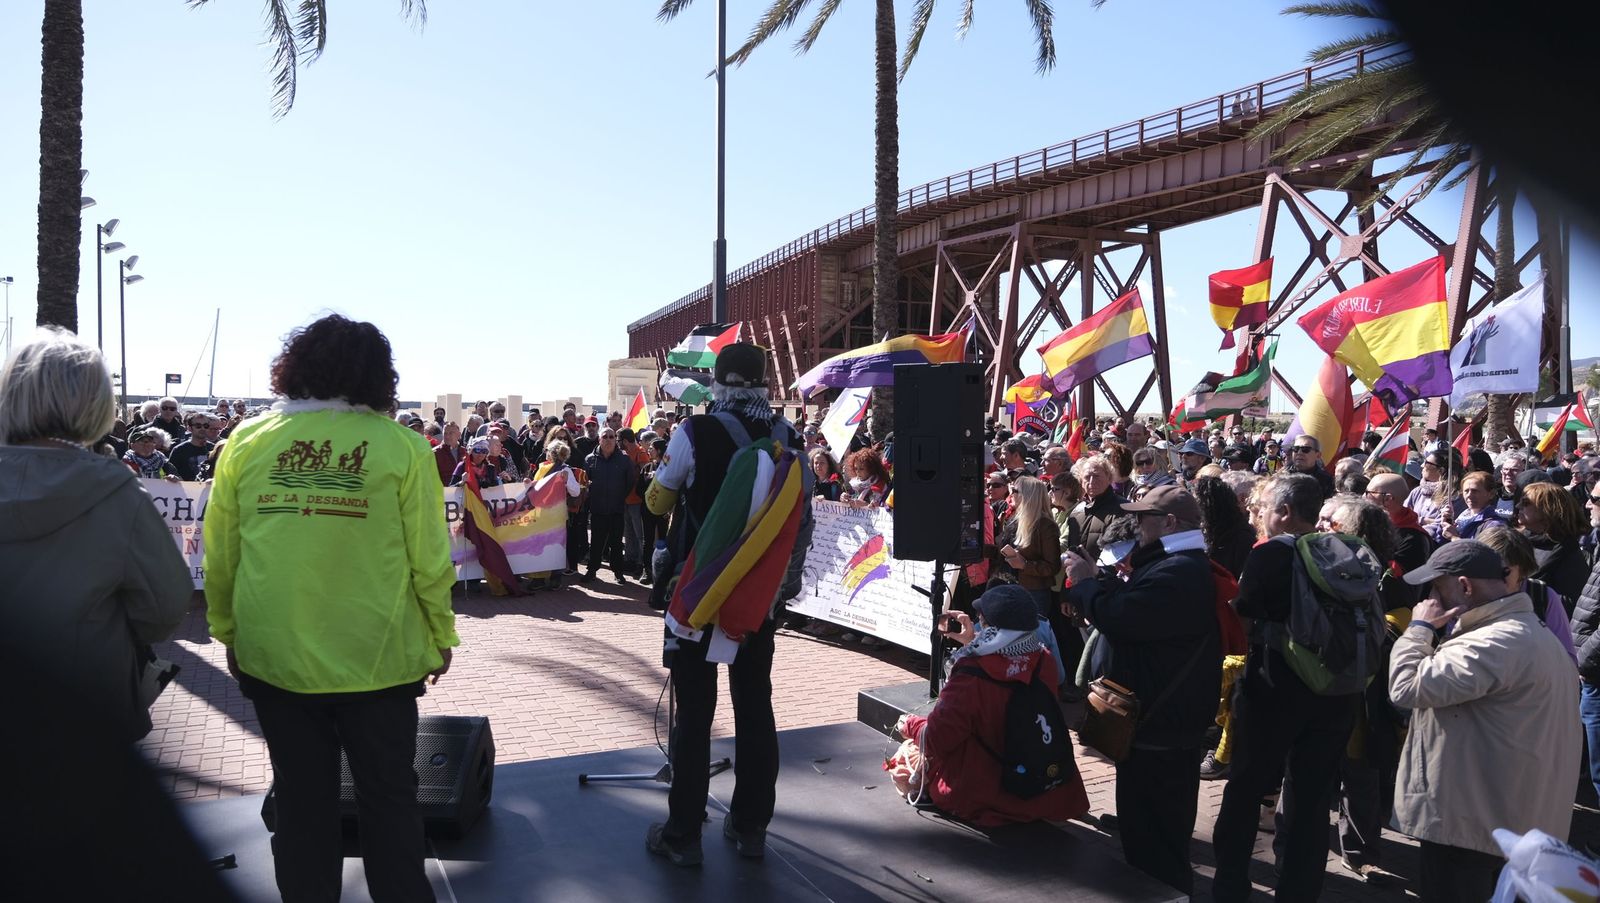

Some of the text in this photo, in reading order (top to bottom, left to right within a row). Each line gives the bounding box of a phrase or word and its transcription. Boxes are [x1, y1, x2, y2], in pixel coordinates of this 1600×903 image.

[257, 494, 369, 508] ASC LA DESBANDÁ
[815, 502, 830, 513] LAS
[832, 505, 866, 519] MUJERES
[830, 607, 842, 616] ASC
